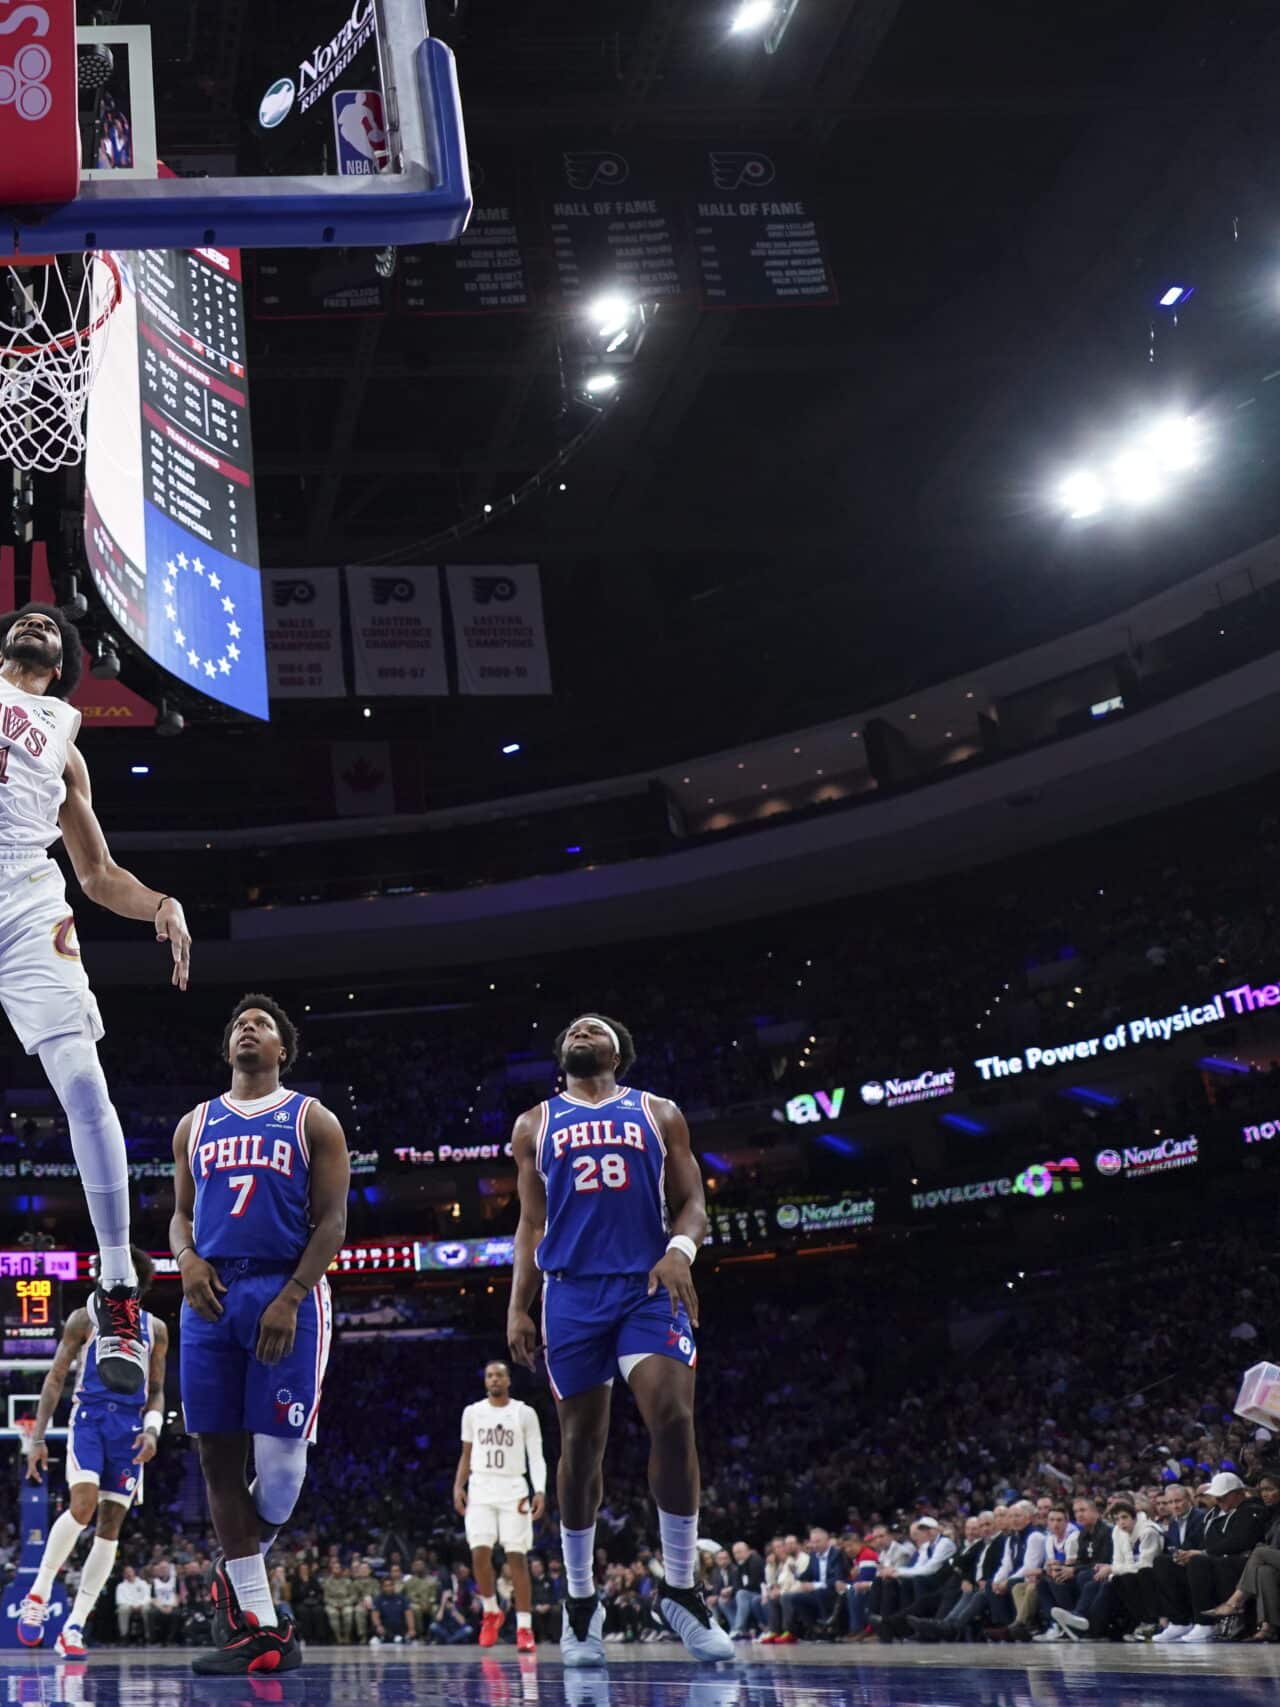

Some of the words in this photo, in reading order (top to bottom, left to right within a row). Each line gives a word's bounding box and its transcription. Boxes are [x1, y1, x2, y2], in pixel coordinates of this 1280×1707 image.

[346, 160, 370, 175] NBA
[476, 208, 511, 221] AME
[553, 203, 591, 216] HALL
[593, 202, 611, 216] OF
[615, 200, 657, 214] FAME
[697, 203, 737, 216] HALL
[740, 203, 759, 216] OF
[761, 203, 806, 216] FAME
[166, 426, 189, 450] TEAM
[186, 441, 220, 469] LEADERS
[215, 429, 227, 443] TO
[975, 1056, 1022, 1081] The
[1024, 1037, 1100, 1070] Power
[1103, 1024, 1127, 1052] of
[1129, 994, 1225, 1043] Physical
[885, 1068, 956, 1098] NovaCare
[552, 1120, 647, 1159] PHILA
[1122, 1134, 1198, 1168] NovaCare
[199, 1135, 296, 1179] PHILA
[394, 1146, 435, 1164] The
[439, 1142, 501, 1163] Power
[572, 1153, 630, 1193] 28
[229, 1173, 257, 1217] 7
[1, 1255, 45, 1276] 5:0
[16, 1280, 52, 1297] 5:08
[22, 1297, 49, 1325] 13
[274, 1400, 305, 1427] 76
[477, 1424, 515, 1448] CAVS
[485, 1449, 505, 1469] 10
